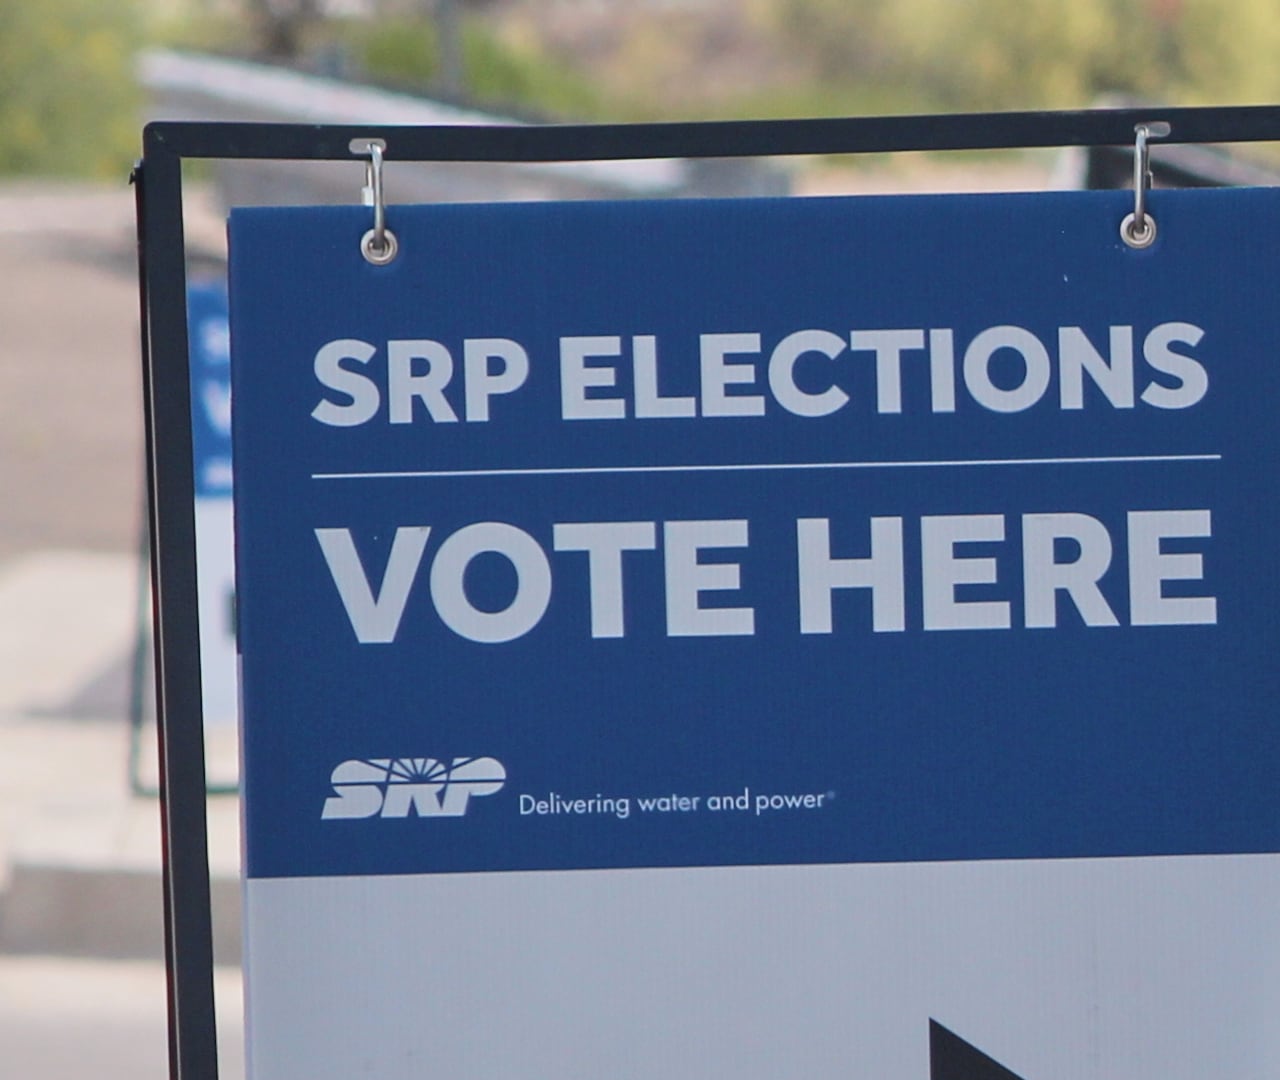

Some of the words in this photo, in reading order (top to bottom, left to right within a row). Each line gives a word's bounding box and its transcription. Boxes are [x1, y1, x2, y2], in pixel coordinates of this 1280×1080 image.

[311, 338, 531, 427] SRP
[559, 322, 1209, 422] ELECTIONS
[314, 519, 755, 644] VOTE
[796, 509, 1219, 634] HERE
[320, 756, 508, 820] SRP
[519, 792, 630, 819] Delivering
[636, 796, 700, 813] water
[706, 787, 749, 811] and
